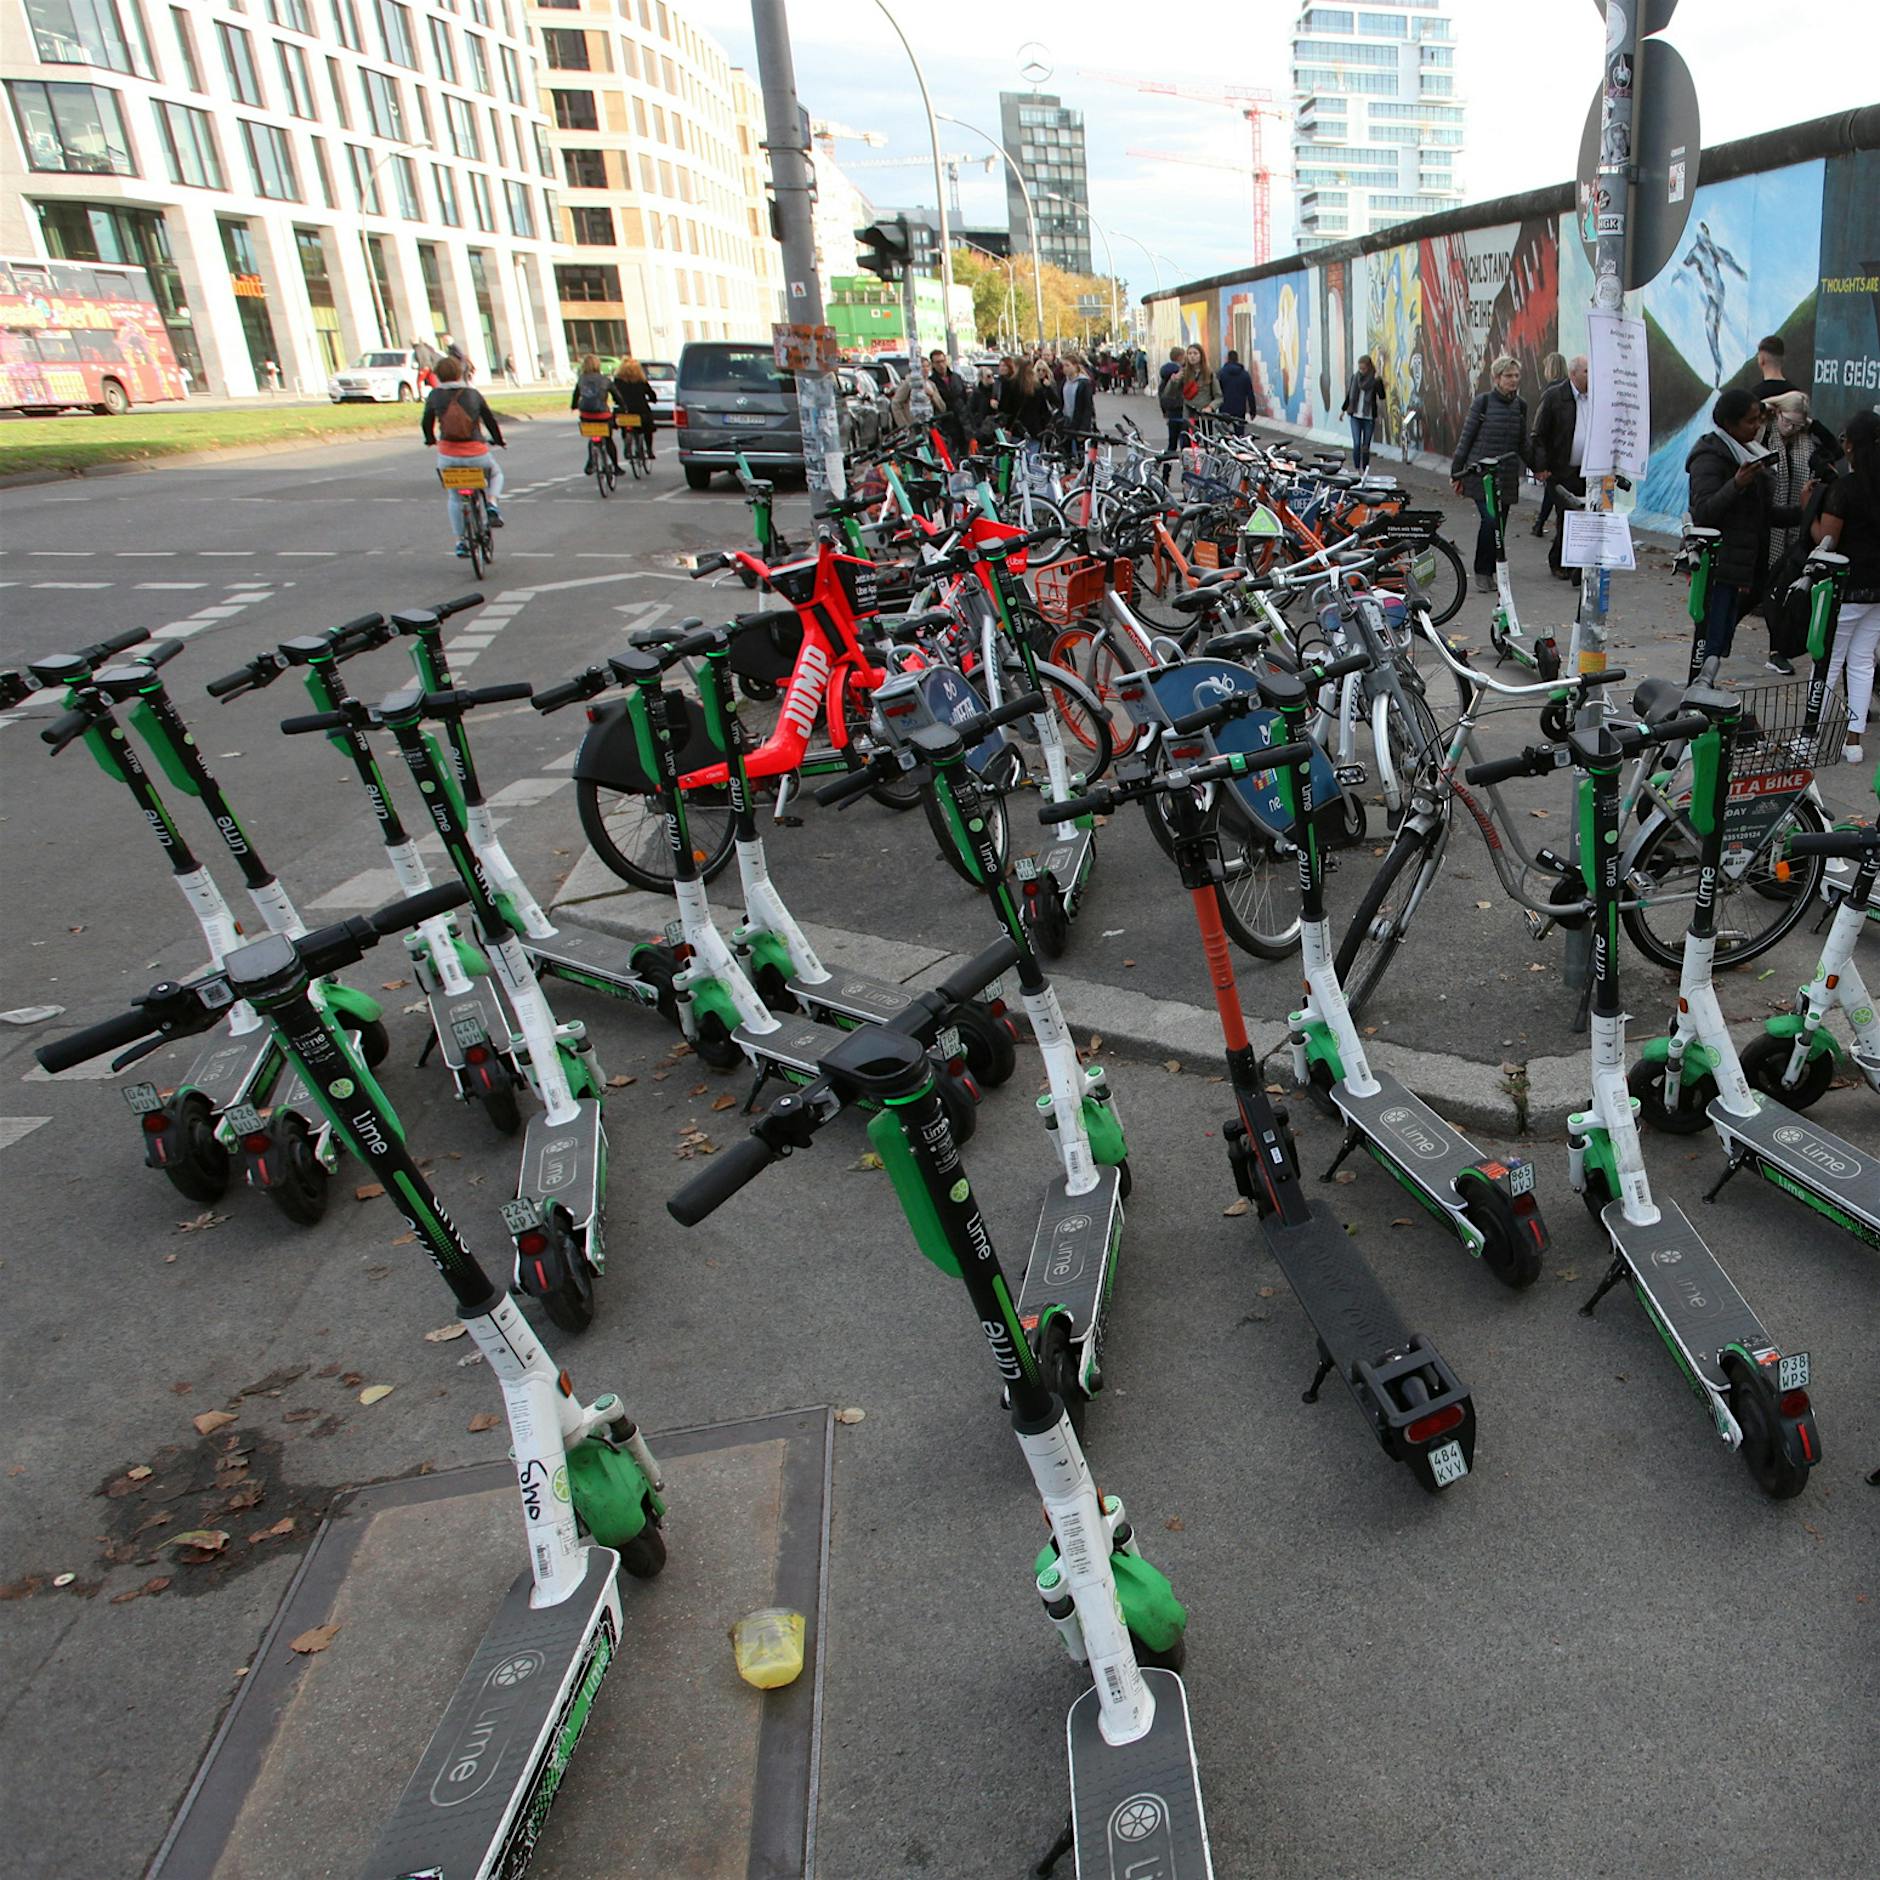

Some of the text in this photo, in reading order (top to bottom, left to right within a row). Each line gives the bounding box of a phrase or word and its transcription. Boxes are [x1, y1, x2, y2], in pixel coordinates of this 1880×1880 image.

[1821, 277, 1879, 293] THOUGHTS ARE
[1814, 359, 1838, 385] DER
[1127, 630, 1155, 665] mobike
[1692, 639, 1706, 669] Lime
[784, 644, 832, 739] JUMP
[1808, 680, 1824, 713] Lime
[355, 727, 370, 751] ime
[730, 720, 741, 744] Lime
[124, 748, 142, 774] Lime
[449, 746, 466, 782] Lime
[665, 750, 676, 776] Lime
[730, 777, 744, 813] Lime
[1302, 783, 1312, 812] Lime
[1748, 780, 1760, 793] A
[1765, 774, 1804, 790] BIKE
[367, 784, 389, 820] Lime
[431, 802, 452, 833] Lime
[1727, 807, 1747, 817] DAY
[147, 808, 173, 848] Lime
[218, 815, 247, 857] Lime
[665, 812, 681, 851] Lime
[979, 842, 998, 873] Lime
[1297, 849, 1311, 891] Lime
[1606, 855, 1616, 887] Lime
[473, 857, 497, 907] Lime
[1697, 866, 1715, 908] Lime
[1595, 932, 1606, 982] Lime
[864, 991, 900, 1006] Lime
[455, 1020, 477, 1037] 449
[230, 1106, 254, 1121] 426
[351, 1110, 388, 1155] Lime
[1400, 1124, 1435, 1153] Lime
[546, 1155, 563, 1186] Lime
[1802, 1142, 1846, 1172] Lime
[1511, 1165, 1530, 1182] 865
[1778, 1175, 1806, 1200] Lime
[503, 1200, 529, 1218] 224
[966, 1211, 991, 1261] Lime
[1052, 1242, 1074, 1276] Lime
[1674, 1272, 1707, 1309] Lime
[980, 1320, 1022, 1381] Lime
[1781, 1358, 1807, 1374] 938
[1782, 1372, 1807, 1389] WPS
[1433, 1445, 1458, 1466] 484
[1437, 1461, 1462, 1482] KYY
[583, 1649, 610, 1702] Lime
[448, 1706, 498, 1784] Lime
